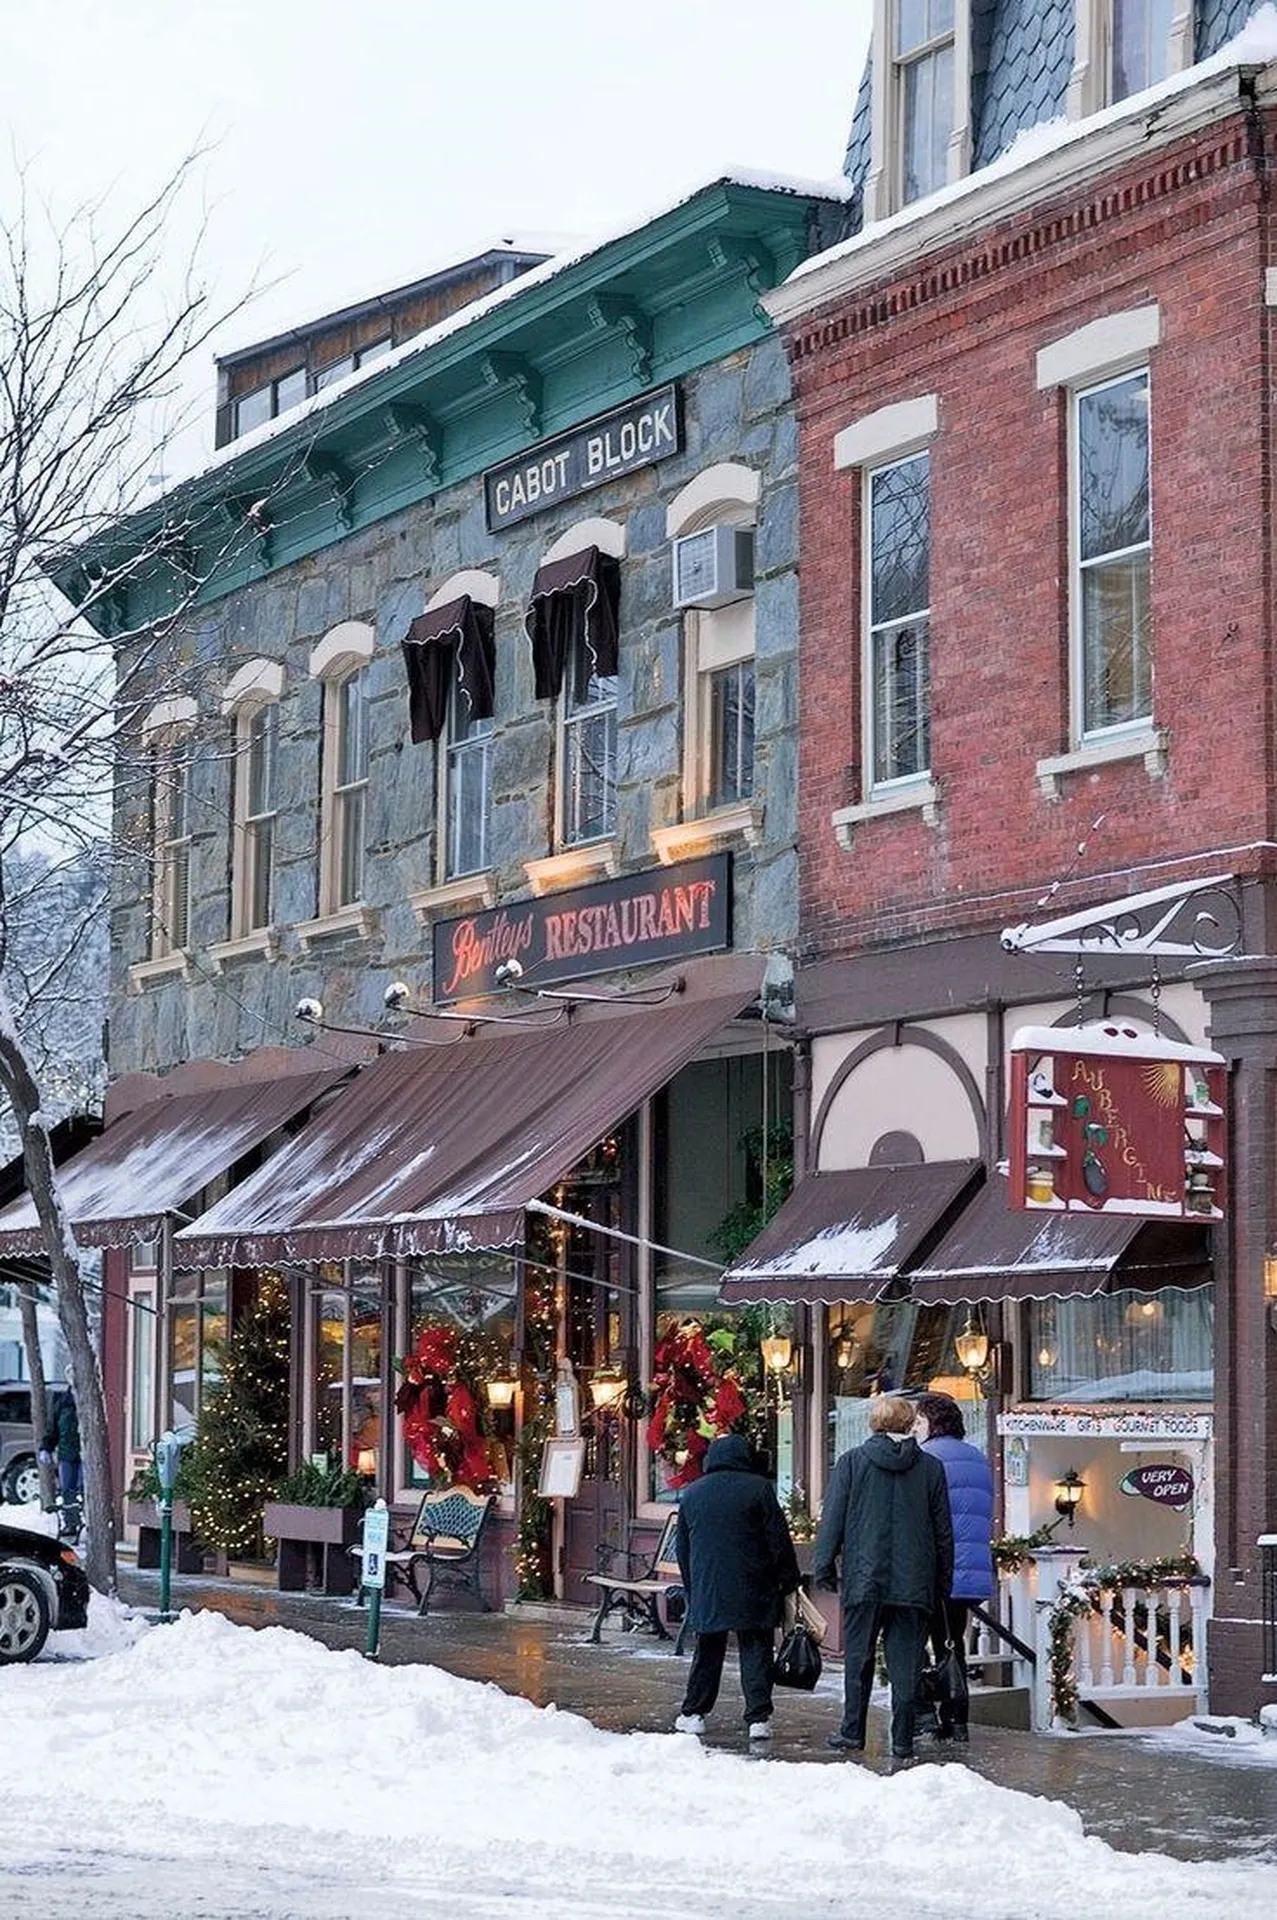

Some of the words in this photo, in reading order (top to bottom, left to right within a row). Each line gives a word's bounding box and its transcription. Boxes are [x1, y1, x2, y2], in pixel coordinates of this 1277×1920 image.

[495, 451, 570, 515] CABOT
[588, 404, 673, 475] BLOCK
[544, 880, 716, 960] RESTAURANT
[1006, 1418, 1066, 1434] KITCHENWARE
[1077, 1418, 1102, 1434] GIFTS
[1113, 1418, 1161, 1434] GOURMET
[1164, 1418, 1199, 1434] FOODS
[1141, 1469, 1176, 1484] VERY
[1153, 1482, 1189, 1498] OPEN
